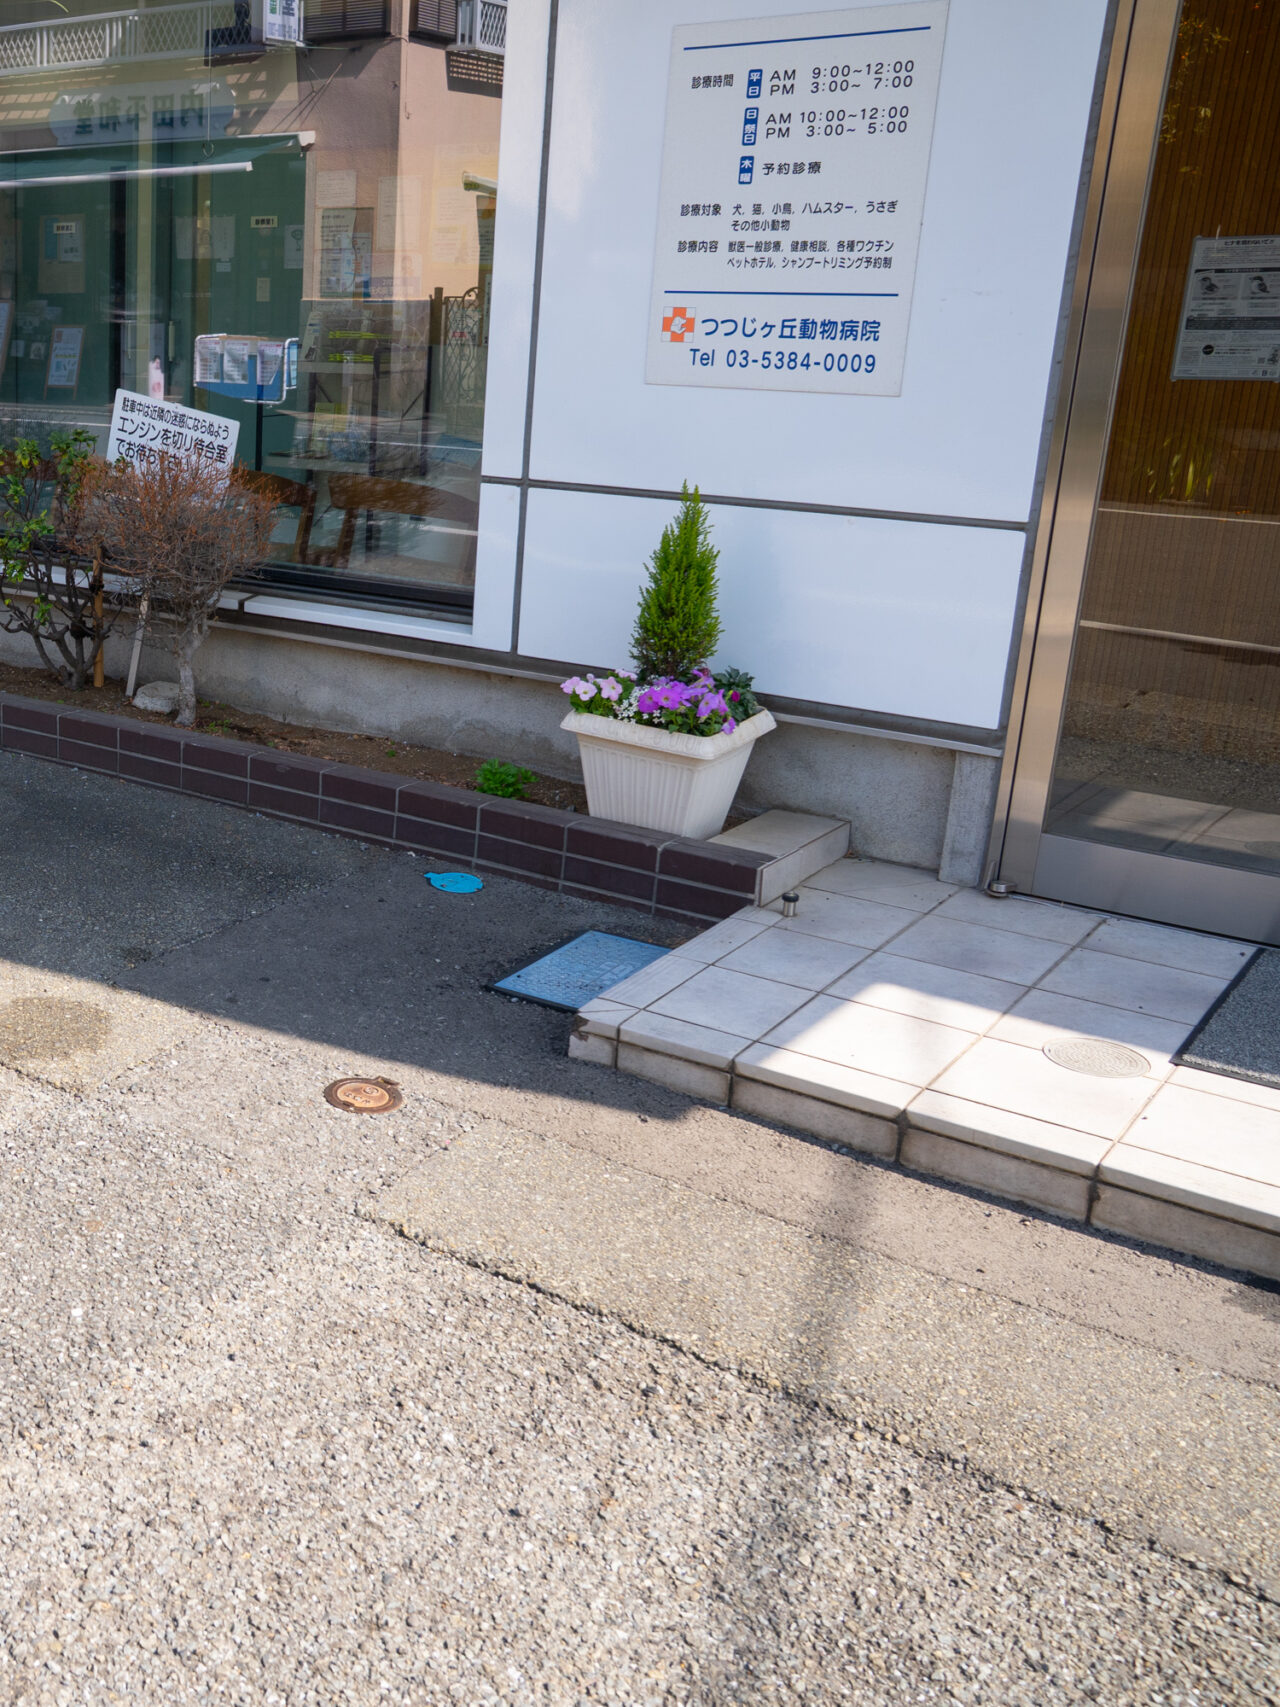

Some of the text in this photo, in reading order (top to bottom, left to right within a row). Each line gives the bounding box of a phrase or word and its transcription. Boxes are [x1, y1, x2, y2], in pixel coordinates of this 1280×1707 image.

[691, 74, 734, 89] 診療時間
[770, 69, 796, 82] AM
[748, 71, 761, 96] 平日
[770, 84, 795, 96] PM
[765, 113, 792, 125] AM
[766, 127, 790, 139] PM
[740, 158, 753, 183] 木曜
[762, 161, 822, 176] 予約診療
[680, 203, 721, 217] 診療対象
[730, 219, 791, 232] その他小動物
[677, 240, 719, 253] 診療内容
[689, 348, 877, 374] Tel 03-5384-0009
[121, 396, 230, 440] 駐車中は近隣の迷惑にならぬよう
[117, 416, 228, 464] エンジンを切り待合室
